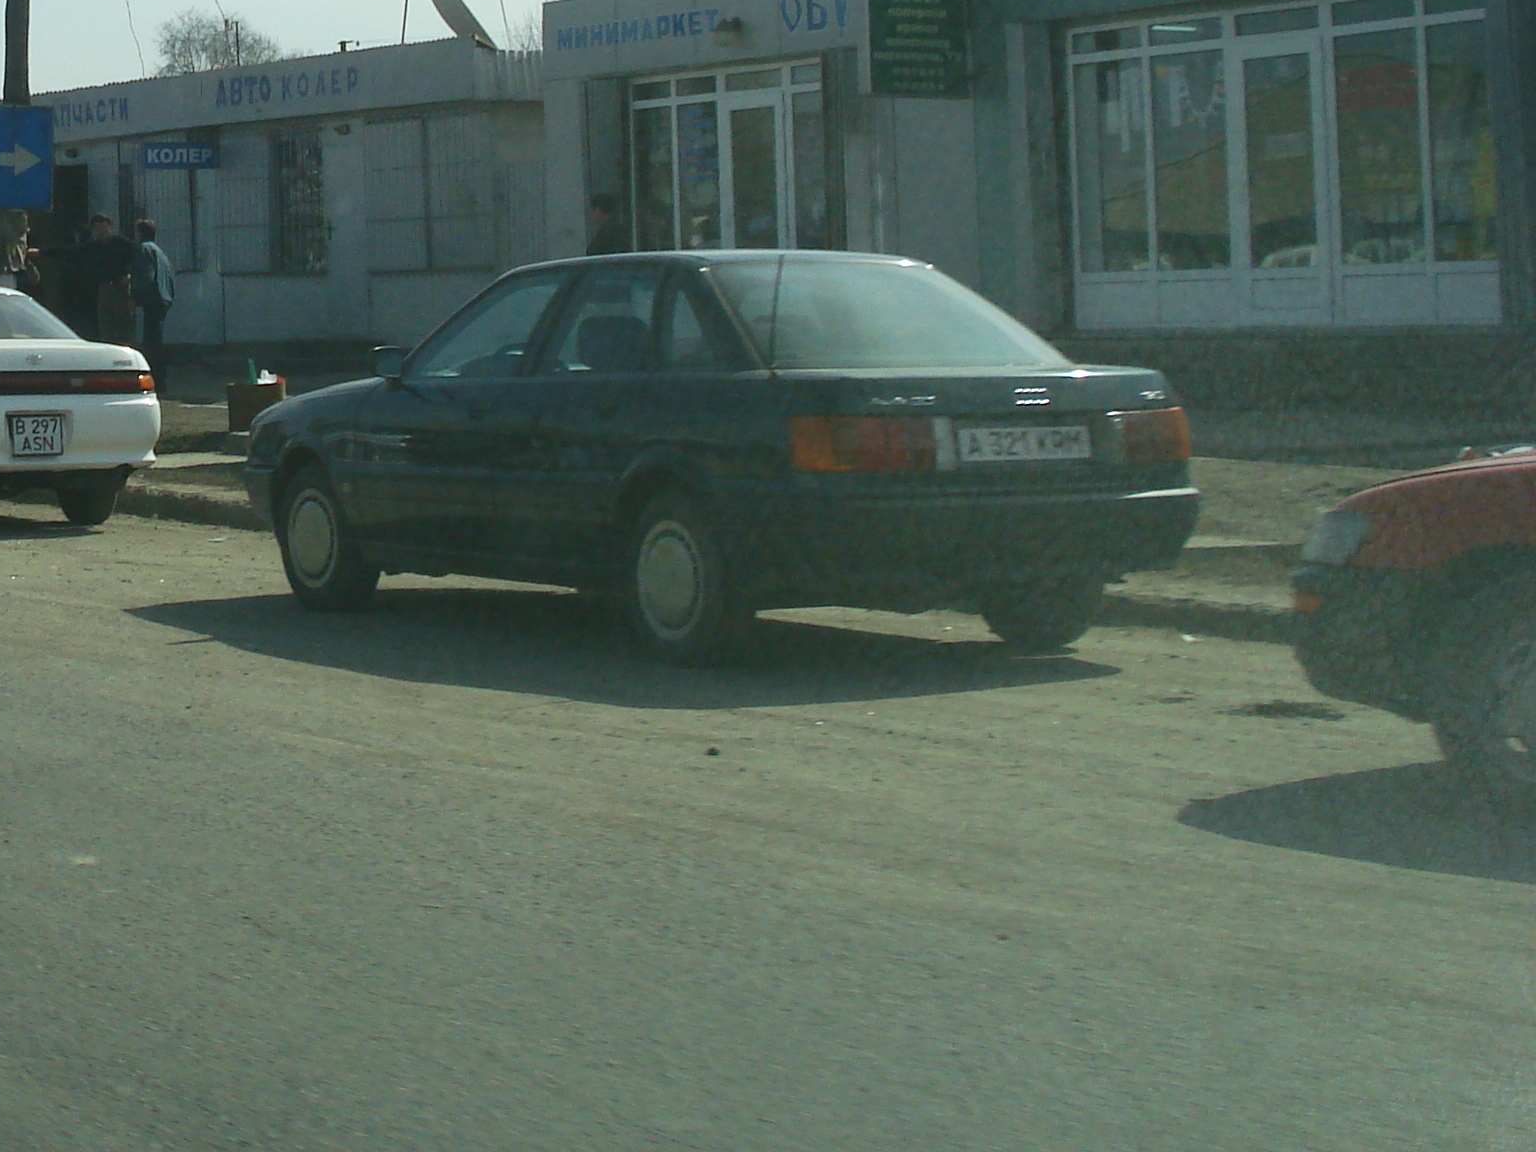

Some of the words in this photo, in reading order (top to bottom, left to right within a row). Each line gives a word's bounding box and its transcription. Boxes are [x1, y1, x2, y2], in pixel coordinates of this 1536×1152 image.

[557, 9, 718, 50] МИНИМАРКЕТ
[215, 75, 271, 107] АВТО
[282, 66, 358, 101] КОЛЕР
[147, 148, 211, 165] КОЛЕР
[15, 419, 26, 435] B
[31, 418, 59, 434] 297
[22, 436, 55, 452] ASN
